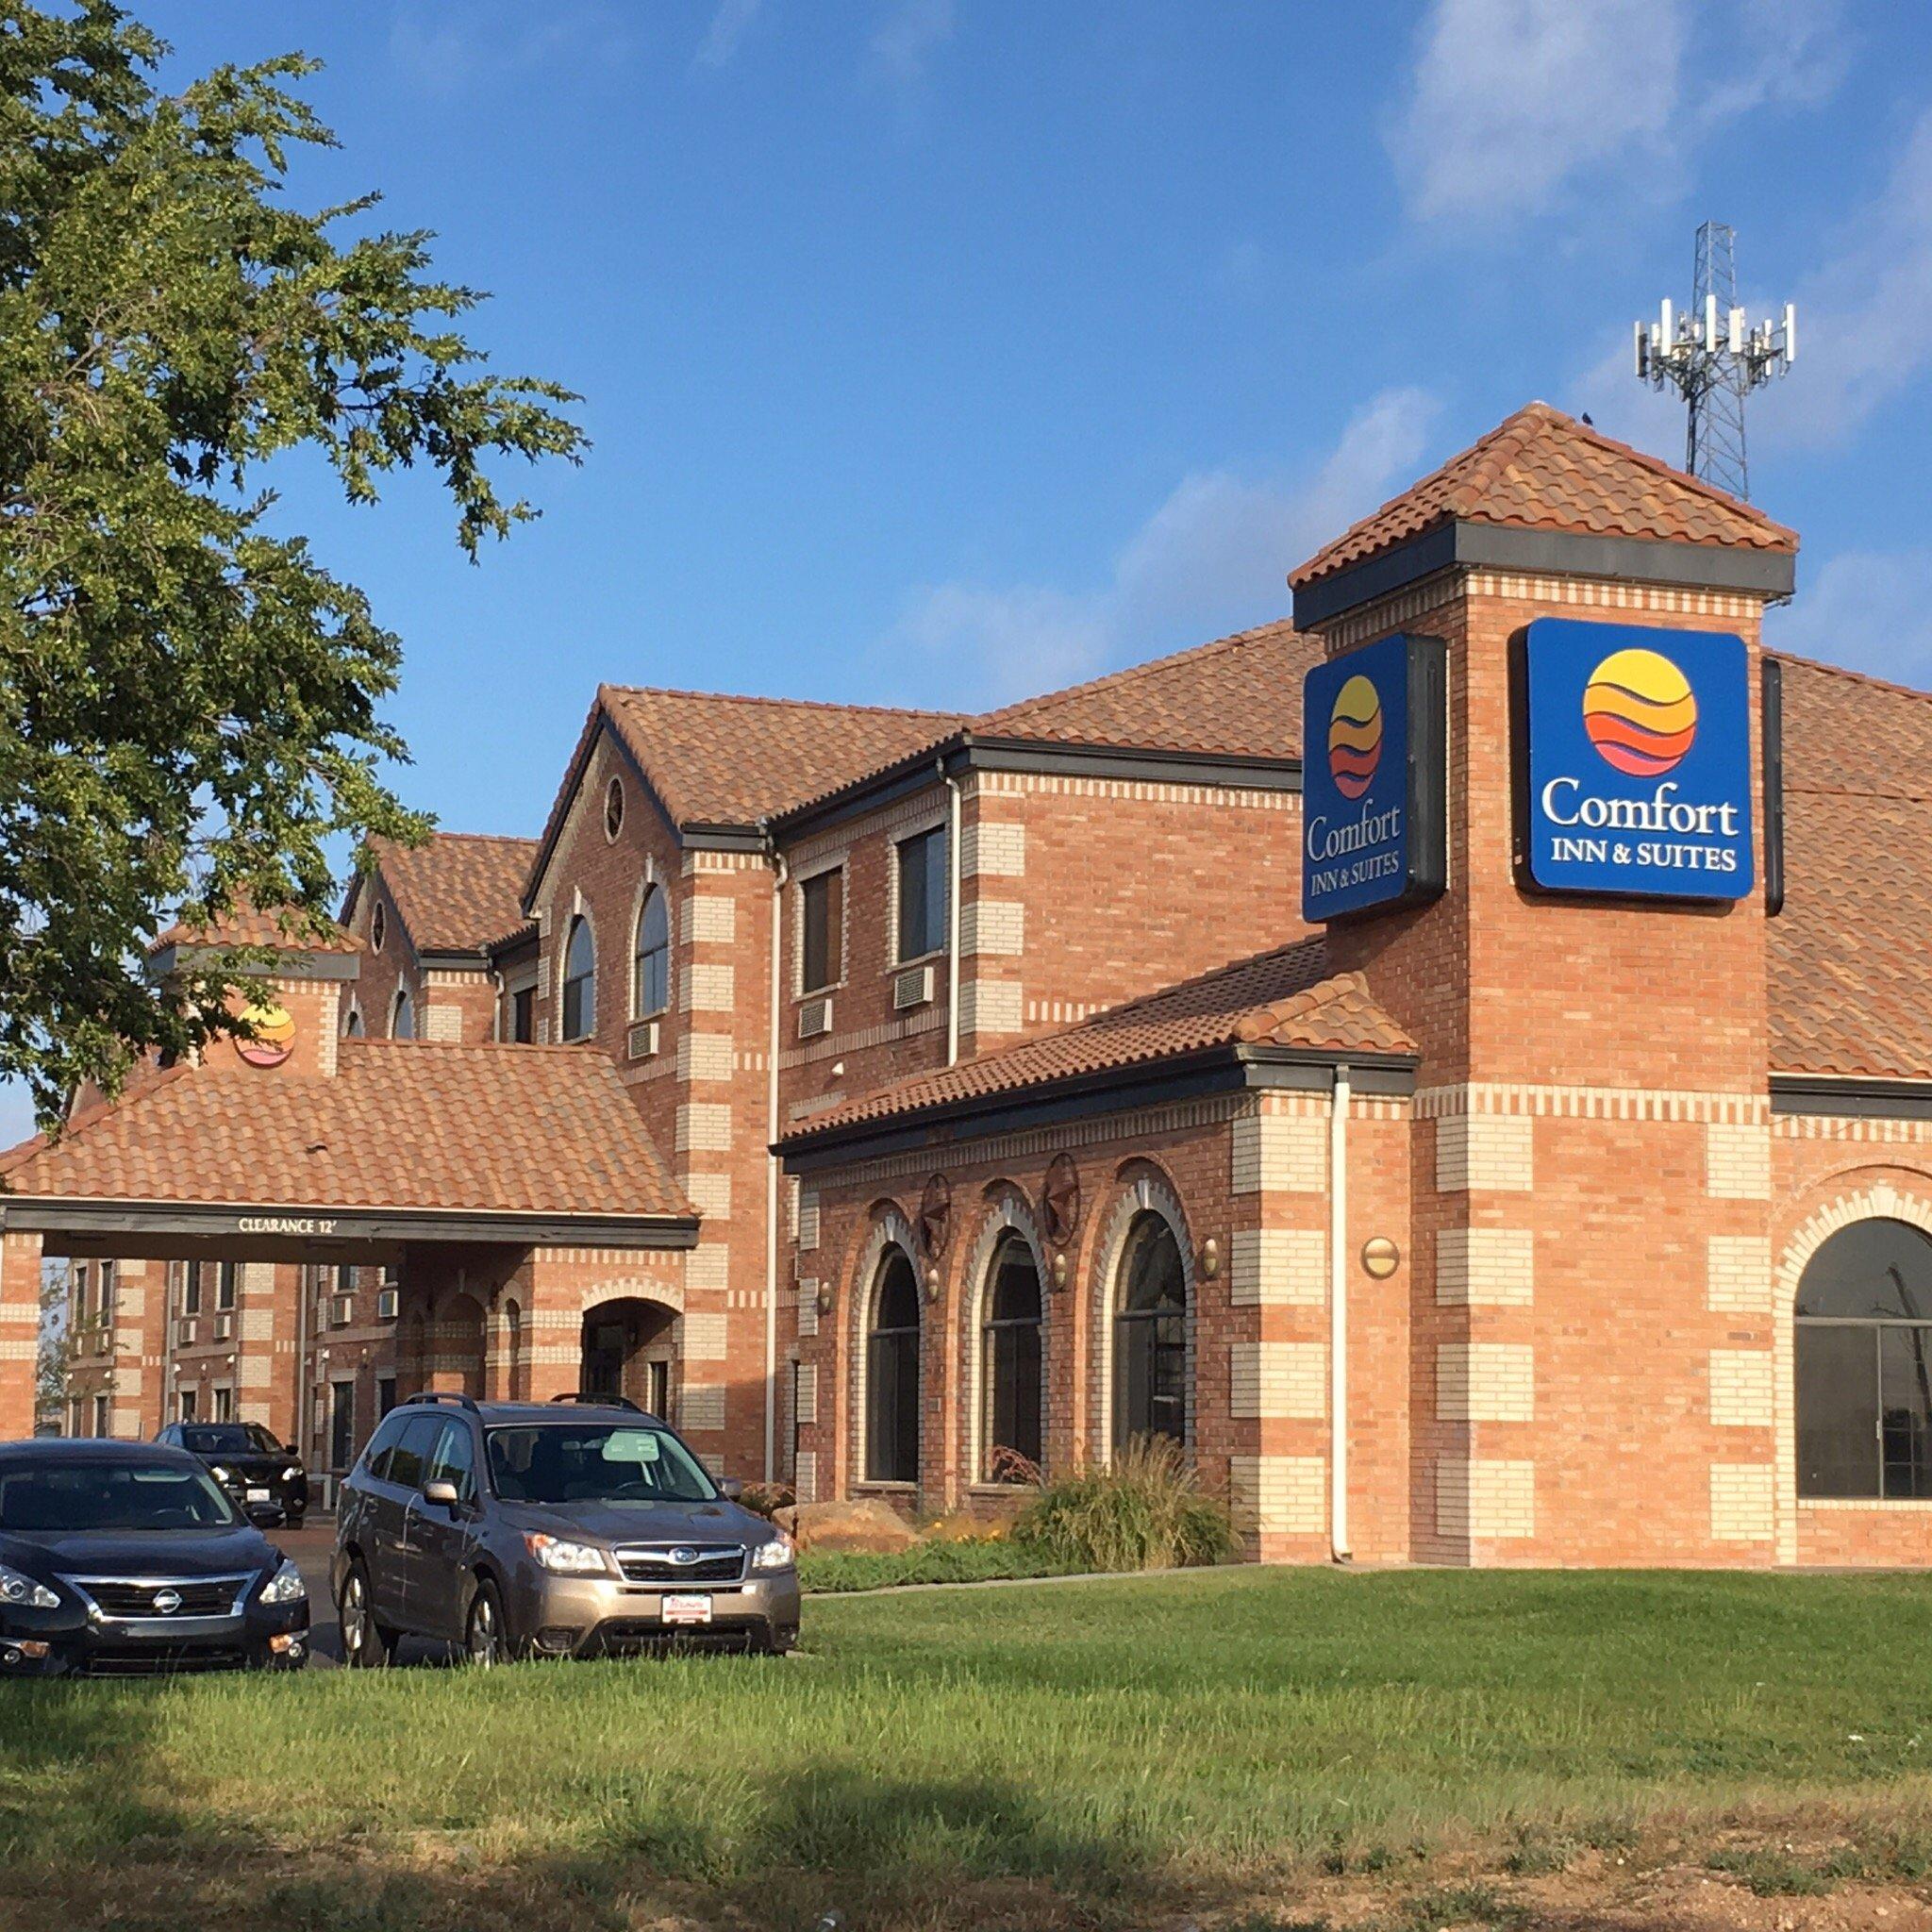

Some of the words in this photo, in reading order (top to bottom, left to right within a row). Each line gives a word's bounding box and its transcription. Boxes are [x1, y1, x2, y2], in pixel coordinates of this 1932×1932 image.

[1307, 798, 1401, 862] Comfort
[1541, 776, 1740, 837] Comfort
[1310, 869, 1340, 897] INN
[1340, 868, 1350, 889] &
[1351, 850, 1400, 886] SUITES
[1550, 837, 1607, 863] INN
[1611, 842, 1632, 865] &
[1636, 842, 1738, 873] SUITES
[238, 1217, 315, 1234] CLEARANCE
